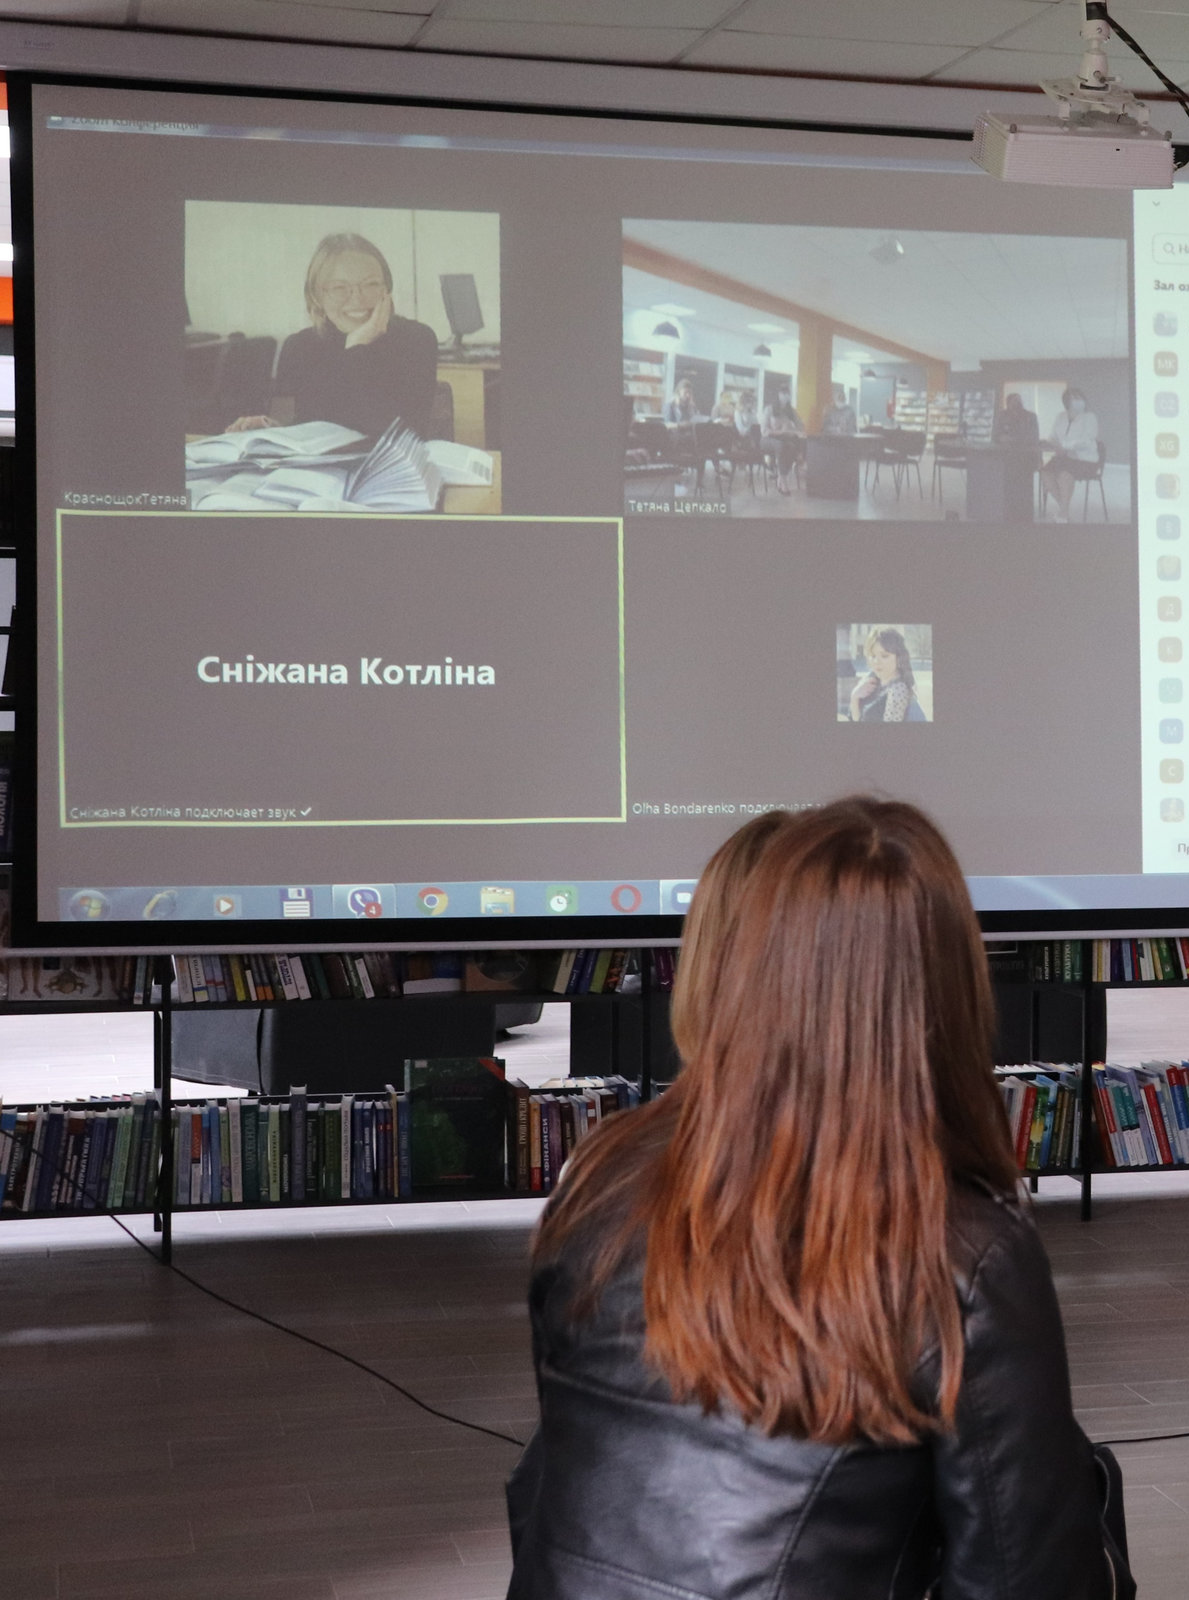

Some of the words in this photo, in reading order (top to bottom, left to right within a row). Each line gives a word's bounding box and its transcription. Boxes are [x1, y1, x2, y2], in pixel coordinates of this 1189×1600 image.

[1153, 280, 1174, 292] Зал
[628, 500, 670, 513] Тетяна
[197, 655, 349, 684] Сніжана
[361, 657, 496, 685] Котліна
[70, 808, 126, 819] Сніжана
[131, 806, 181, 817] Котліна
[186, 807, 264, 819] подключает
[268, 808, 295, 821] звук
[632, 803, 660, 814] Olha
[664, 803, 735, 814] Bondarenko
[369, 905, 377, 915] 4
[542, 1118, 550, 1171] ФІНАНСИ
